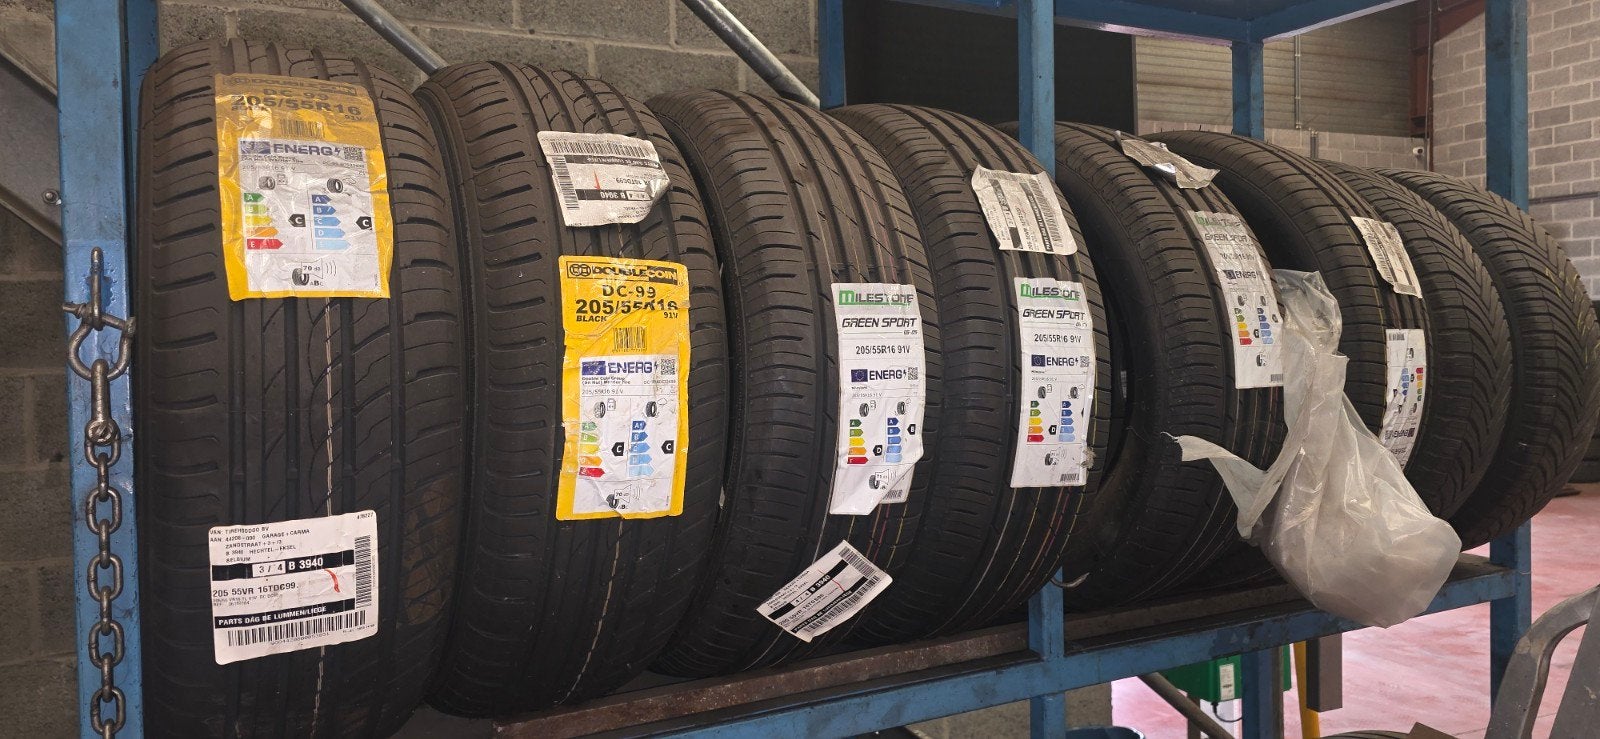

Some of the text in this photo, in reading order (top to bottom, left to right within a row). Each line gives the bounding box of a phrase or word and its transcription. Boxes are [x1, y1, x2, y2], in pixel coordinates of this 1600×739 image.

[263, 88, 329, 101] DC99
[231, 95, 361, 116] 205/55R16
[600, 191, 619, 199] 3940
[602, 285, 656, 299] DC-99
[1021, 284, 1080, 301] MILESONE
[1023, 309, 1086, 320] GREEN SPORT
[842, 317, 917, 328] GREEN SPORT
[856, 345, 911, 355] 205/55R16 91V
[288, 562, 296, 571] B
[300, 557, 324, 569] 3940
[213, 590, 229, 598] 205
[232, 587, 254, 596] 55VR
[218, 618, 247, 626] PARTS
[274, 606, 327, 620] LUMMEN/LIEGE
